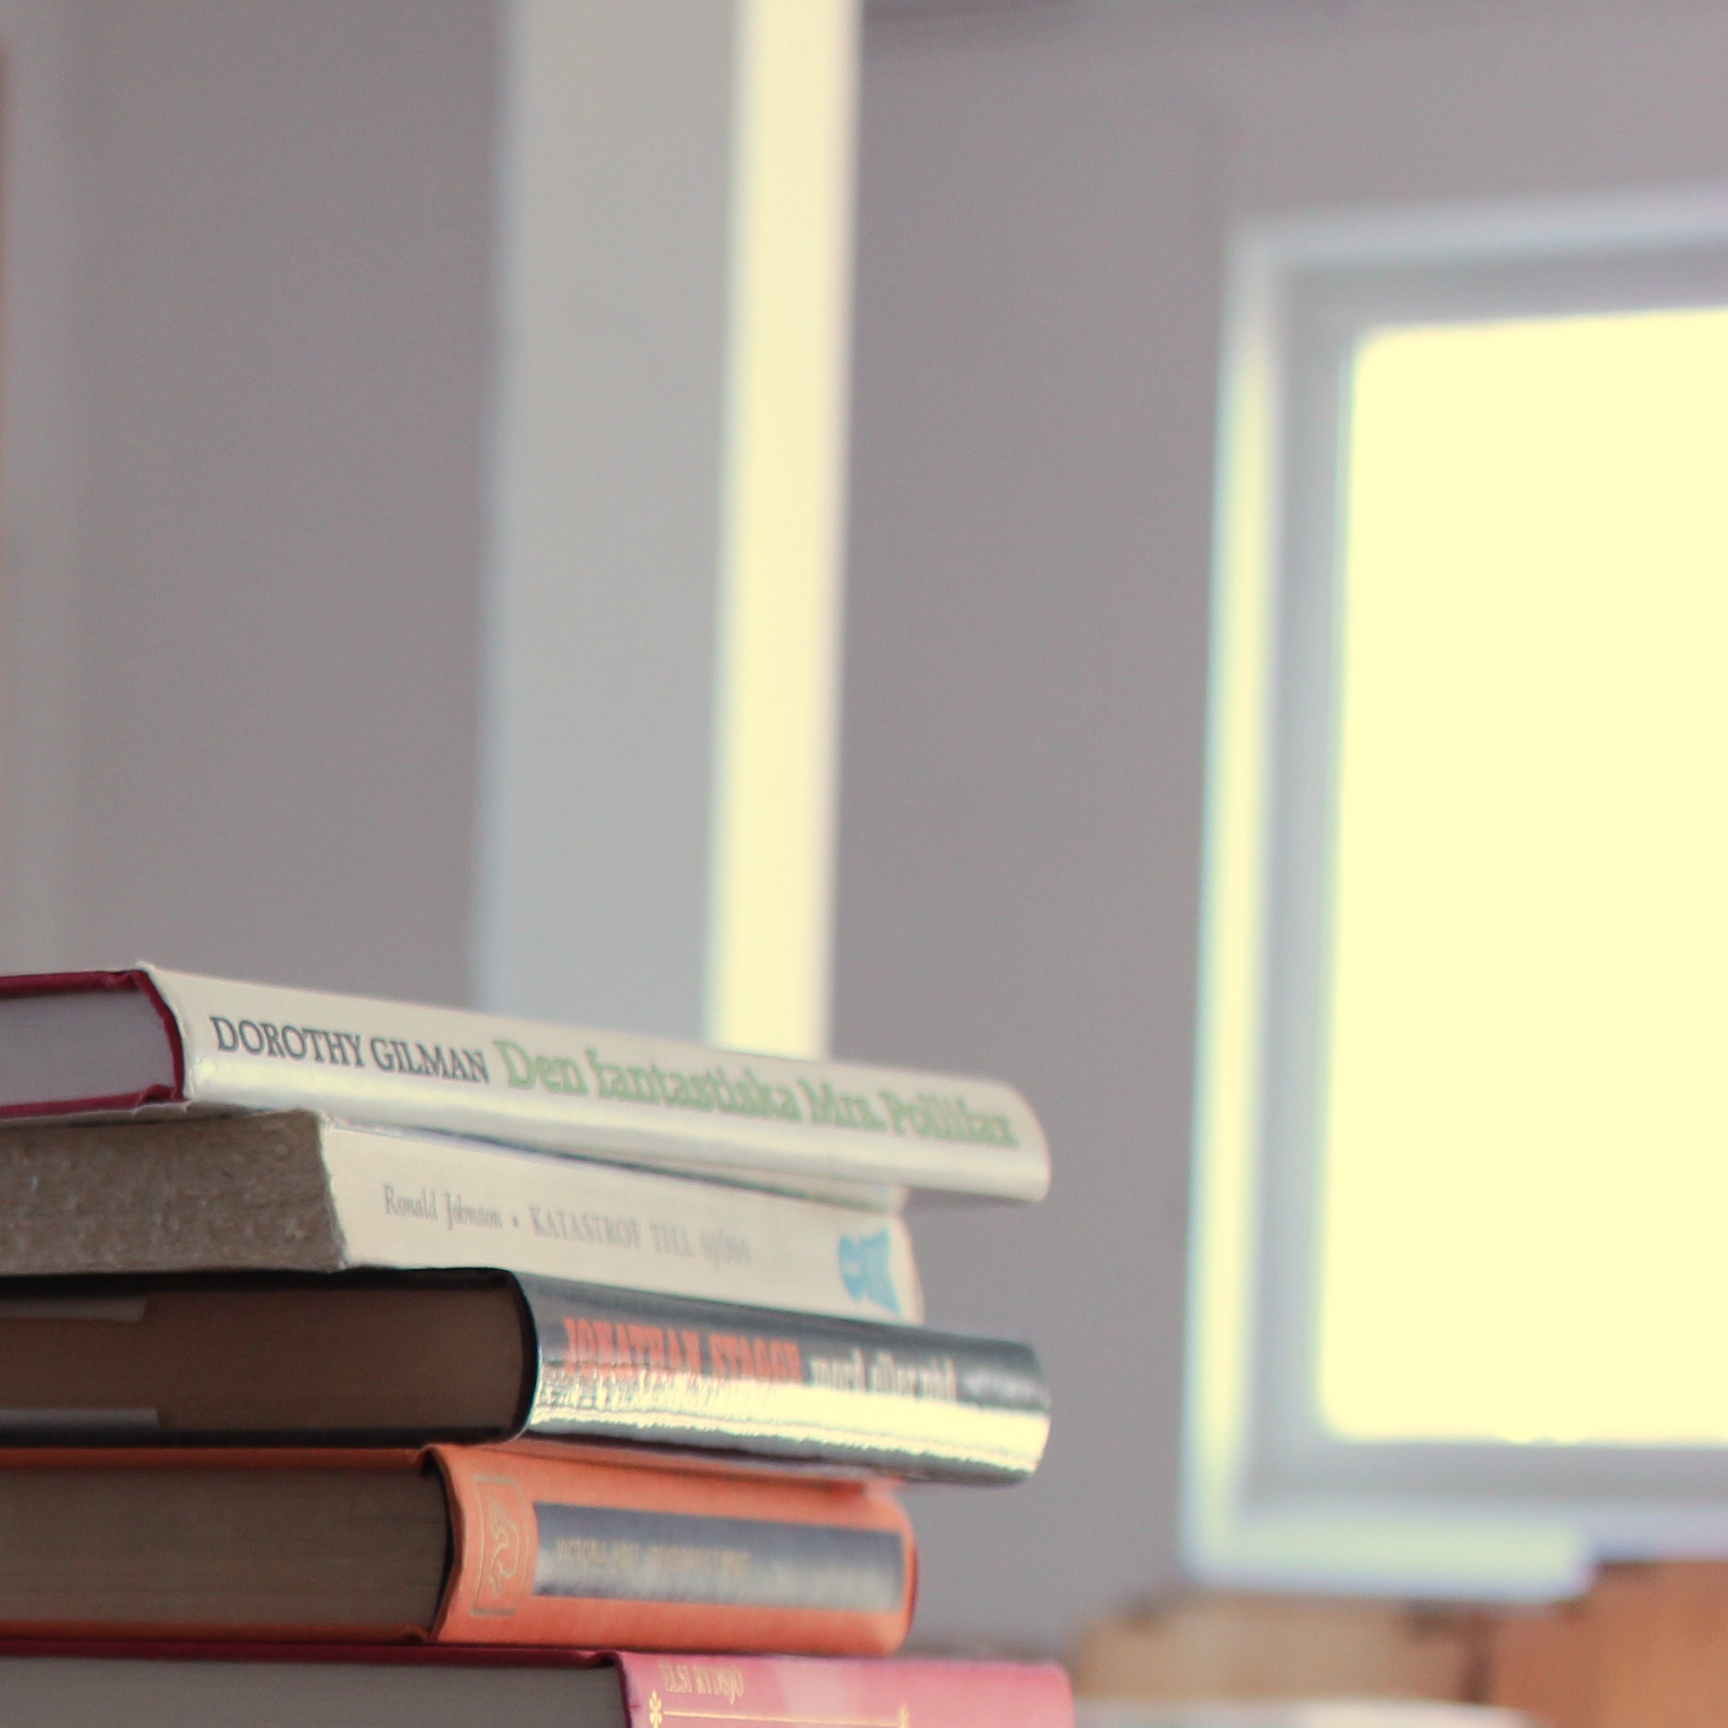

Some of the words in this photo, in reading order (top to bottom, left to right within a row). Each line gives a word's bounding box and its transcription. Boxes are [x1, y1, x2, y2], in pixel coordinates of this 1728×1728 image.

[210, 1014, 366, 1068] DOROTHY
[370, 1037, 492, 1084] GILMAN
[492, 1039, 588, 1097] Den
